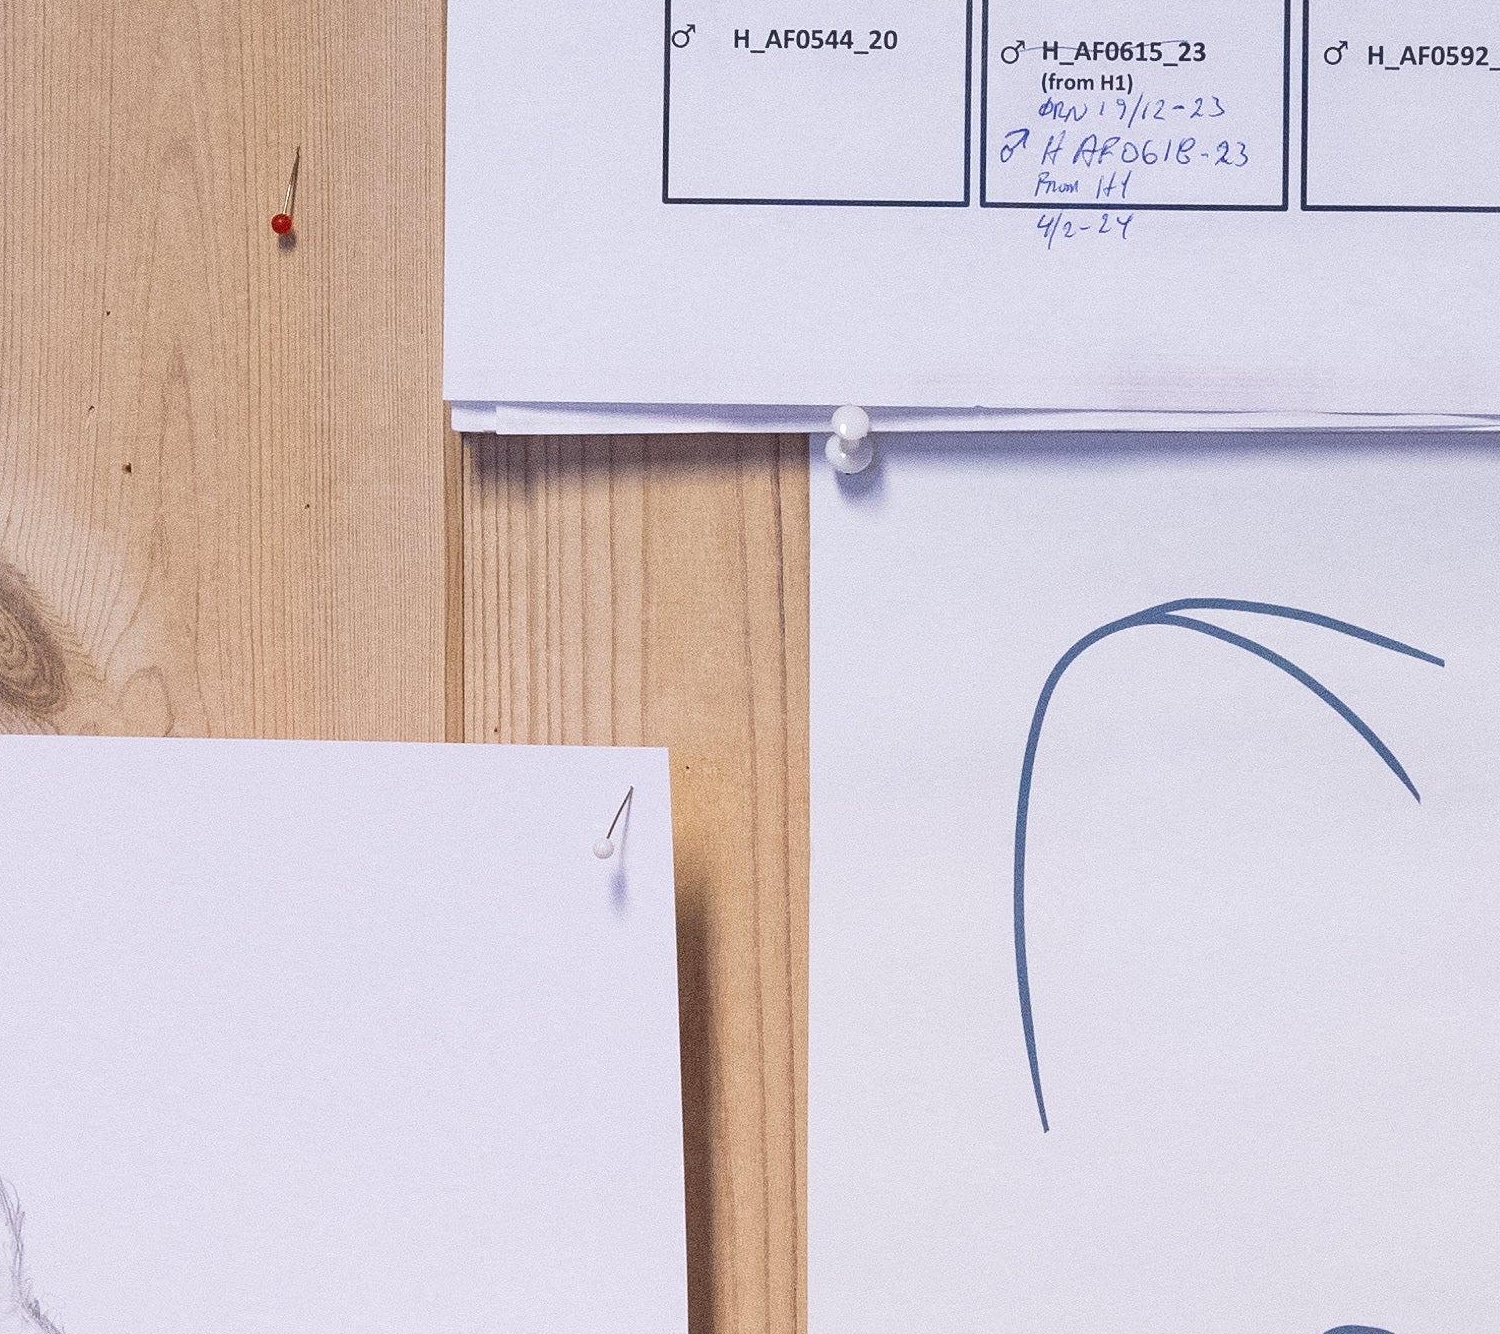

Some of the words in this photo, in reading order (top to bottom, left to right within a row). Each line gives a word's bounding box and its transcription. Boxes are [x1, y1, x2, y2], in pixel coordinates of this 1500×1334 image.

[734, 28, 898, 55] H_AF0544_20
[1042, 40, 1207, 67] H_AF0615_23
[1041, 72, 1095, 94] (from
[1100, 73, 1134, 95] H1)
